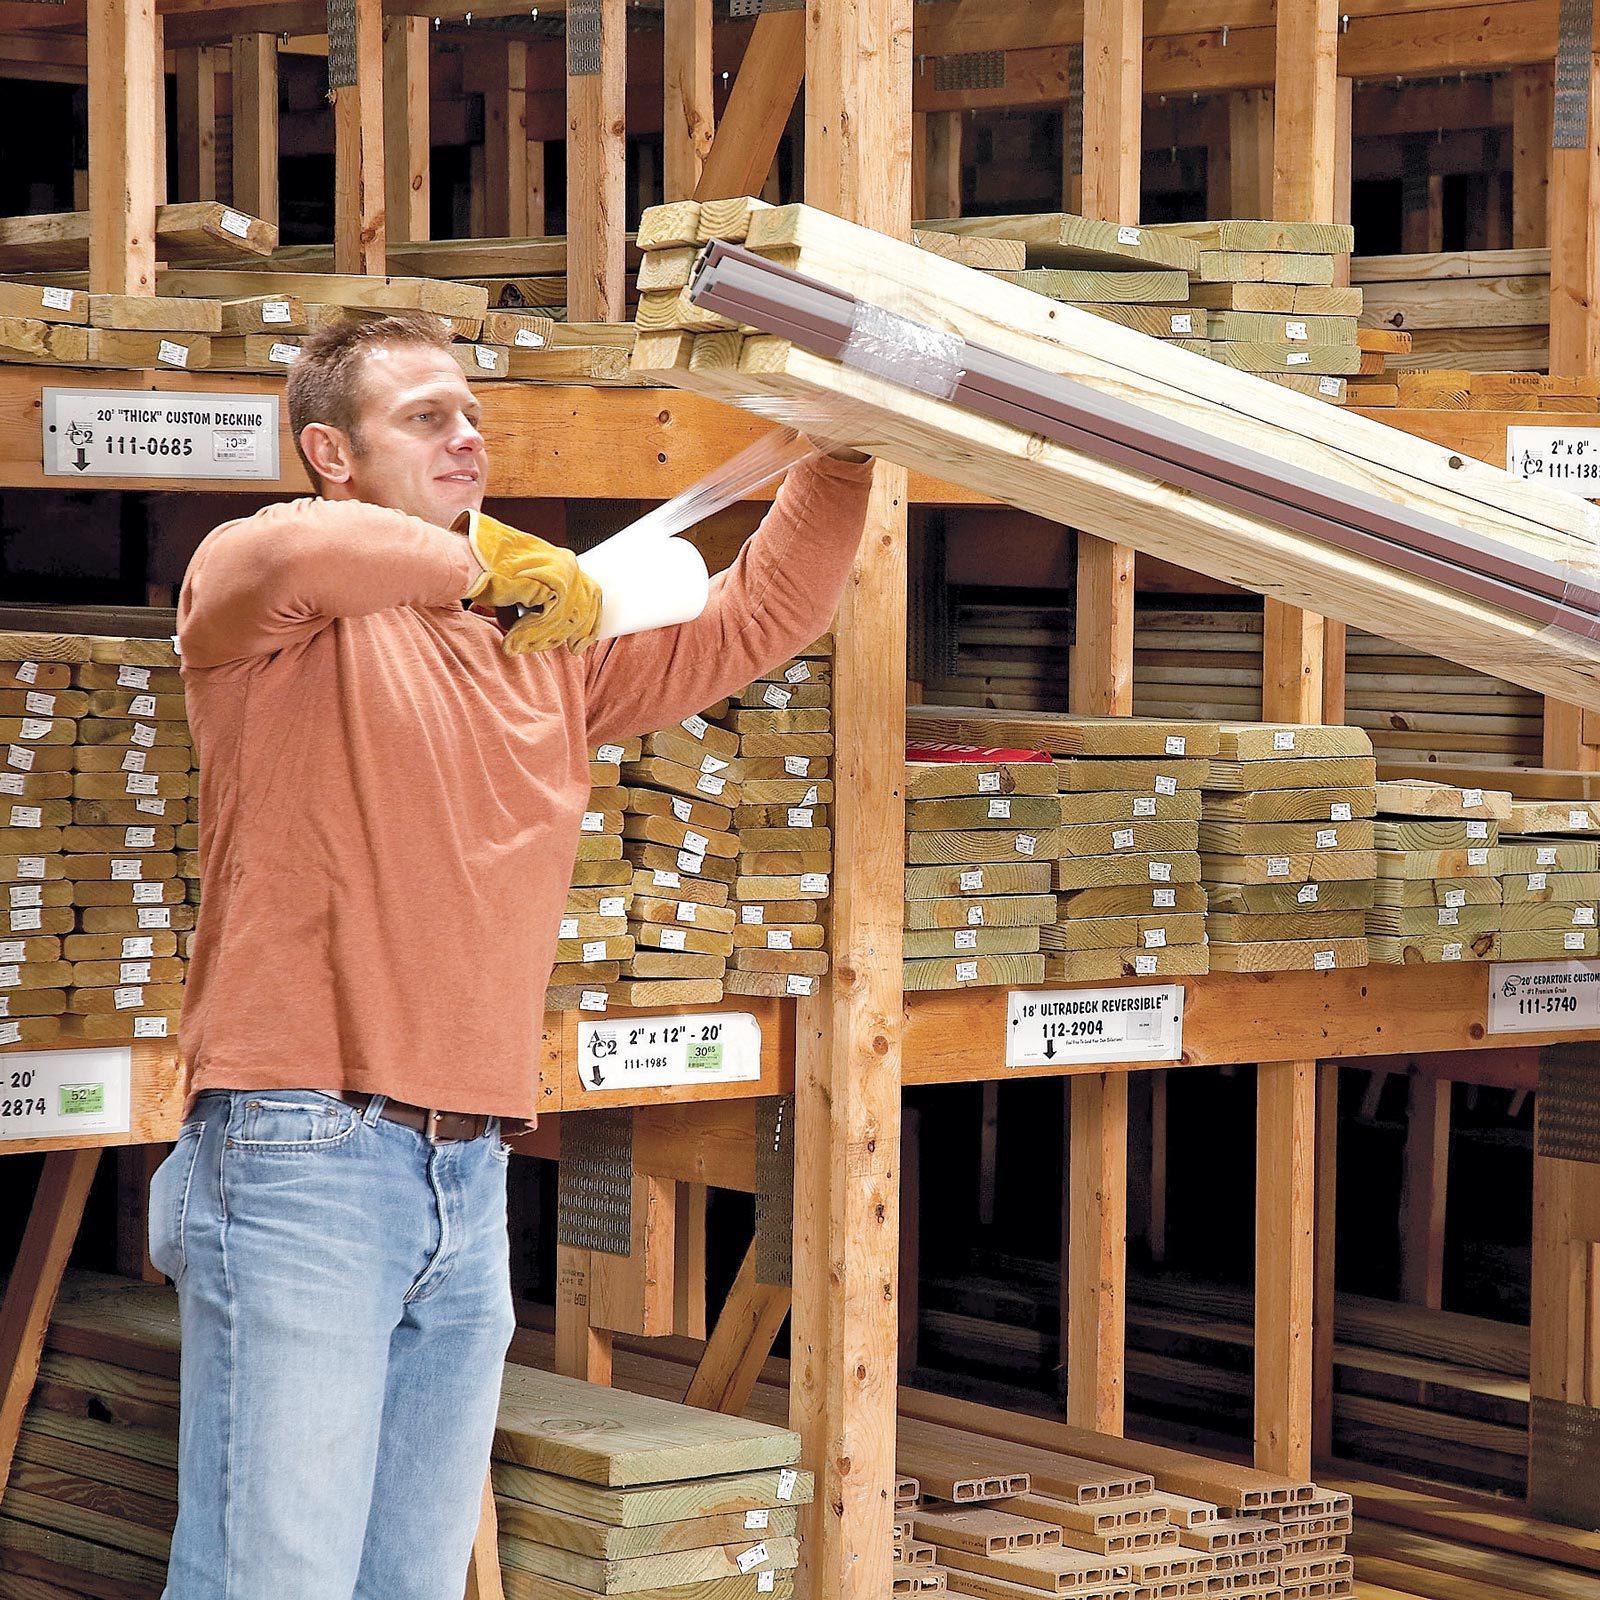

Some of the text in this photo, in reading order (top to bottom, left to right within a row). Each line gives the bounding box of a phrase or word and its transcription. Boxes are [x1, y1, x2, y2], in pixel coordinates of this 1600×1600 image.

[97, 409, 262, 426] 20' "THICK" CUSTOM DECKING
[105, 435, 193, 456] 111-0685
[1551, 440, 1564, 454] 2"
[1567, 444, 1573, 455] x
[1577, 440, 1589, 455] 8"
[1549, 463, 1600, 478] 111-138
[1533, 974, 1571, 985] CEDARTONE
[1023, 1003, 1037, 1018] 18'
[1041, 1000, 1098, 1016] ULTRADECK
[1519, 997, 1577, 1014] 111-5740
[629, 1028, 645, 1045] 2"
[649, 1032, 656, 1044] x
[663, 1026, 686, 1043] 12"
[701, 1023, 722, 1041] 20'
[1042, 1020, 1104, 1038] 112-2904
[624, 1057, 667, 1069] 111-1985
[10, 1069, 35, 1088] 20'
